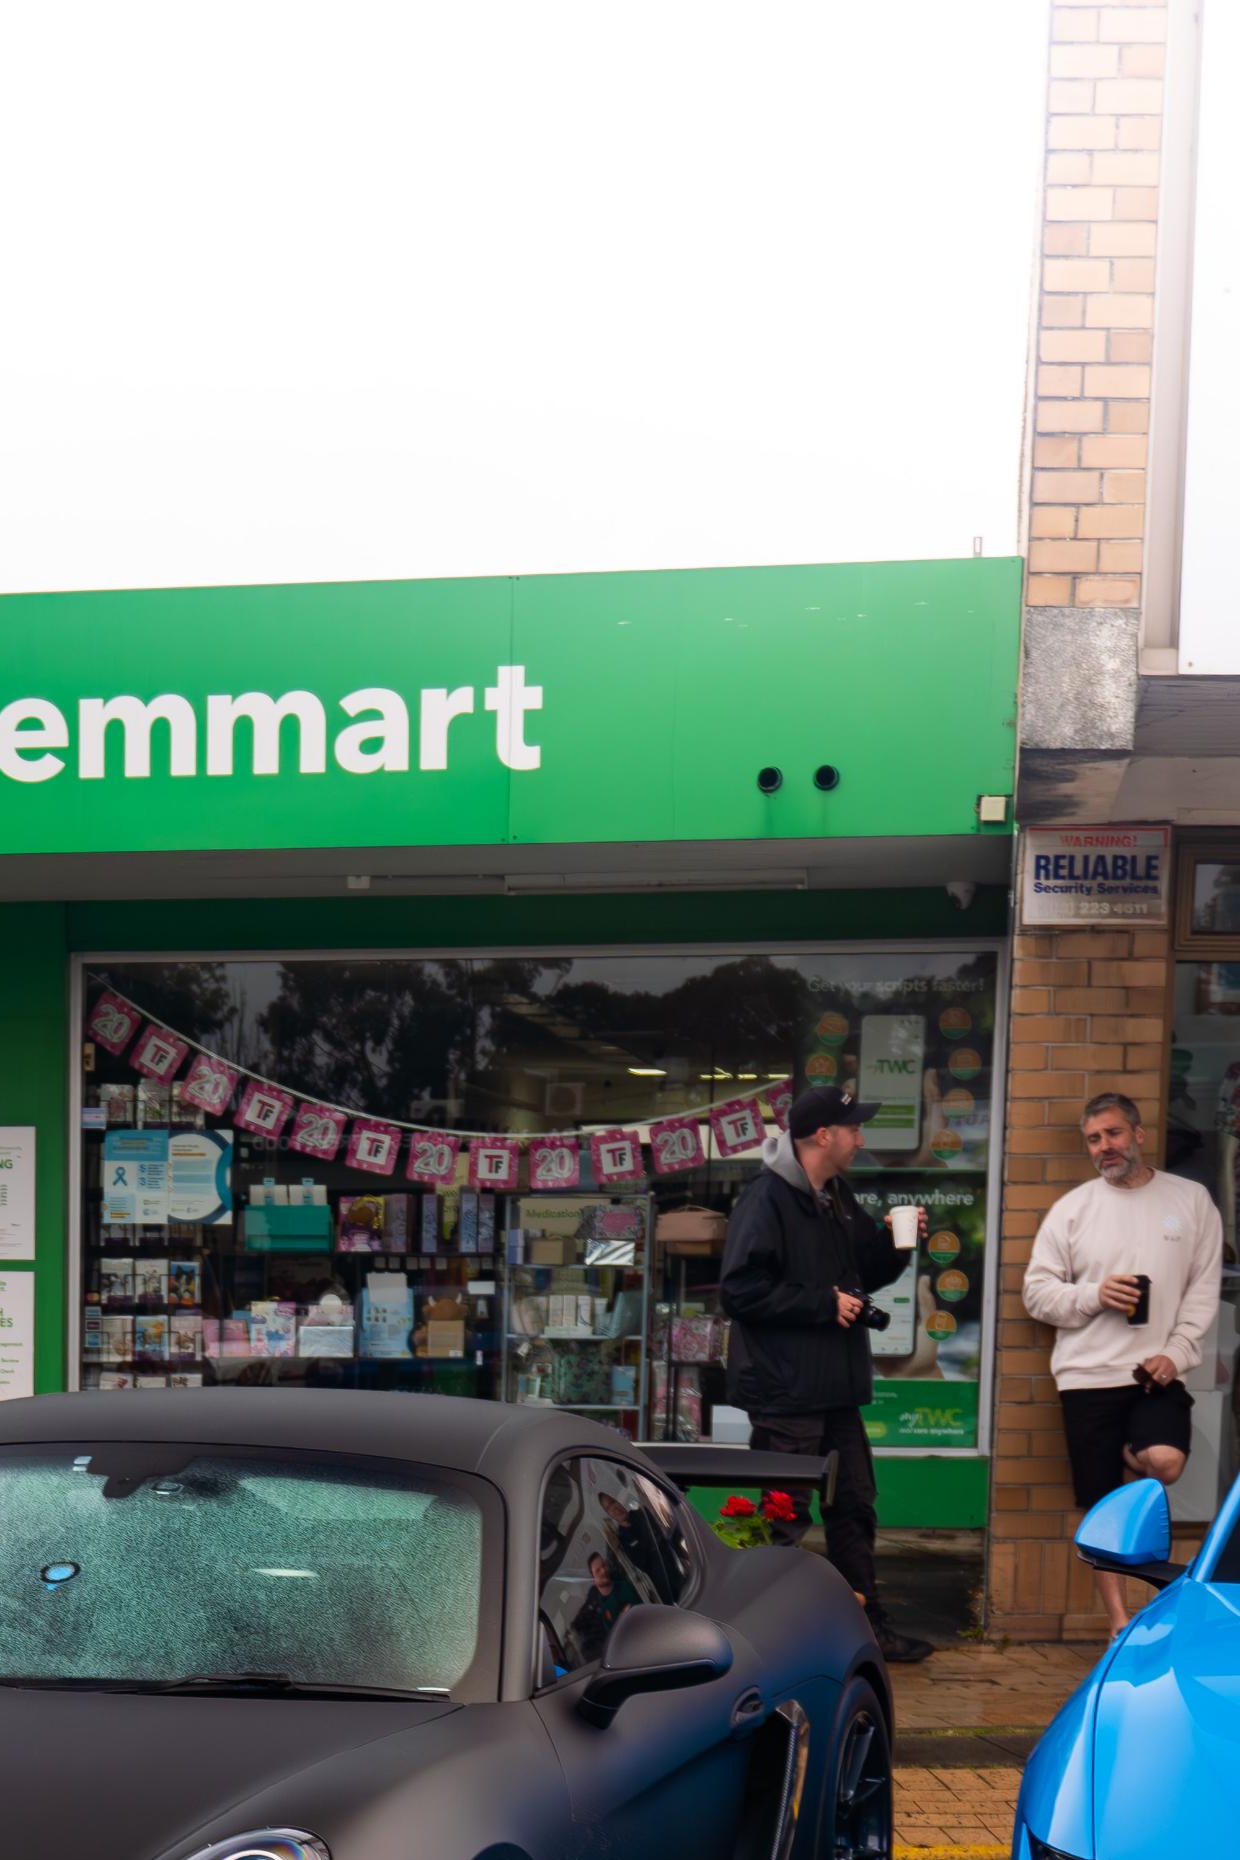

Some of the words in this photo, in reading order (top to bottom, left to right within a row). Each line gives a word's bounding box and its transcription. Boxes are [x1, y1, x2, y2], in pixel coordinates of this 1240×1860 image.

[1034, 854, 1159, 881] RELIABLE
[1034, 882, 1092, 895] Security
[1097, 883, 1158, 894] Services
[808, 976, 835, 993] Get
[875, 978, 927, 997] scripts
[932, 977, 985, 993] faster!
[91, 1004, 131, 1043] 20
[188, 1066, 229, 1104] 20
[297, 1113, 337, 1149] 20
[656, 1128, 697, 1165] 20
[414, 1142, 452, 1175] 20
[536, 1148, 574, 1180] 20
[887, 1188, 975, 1206] anywhere
